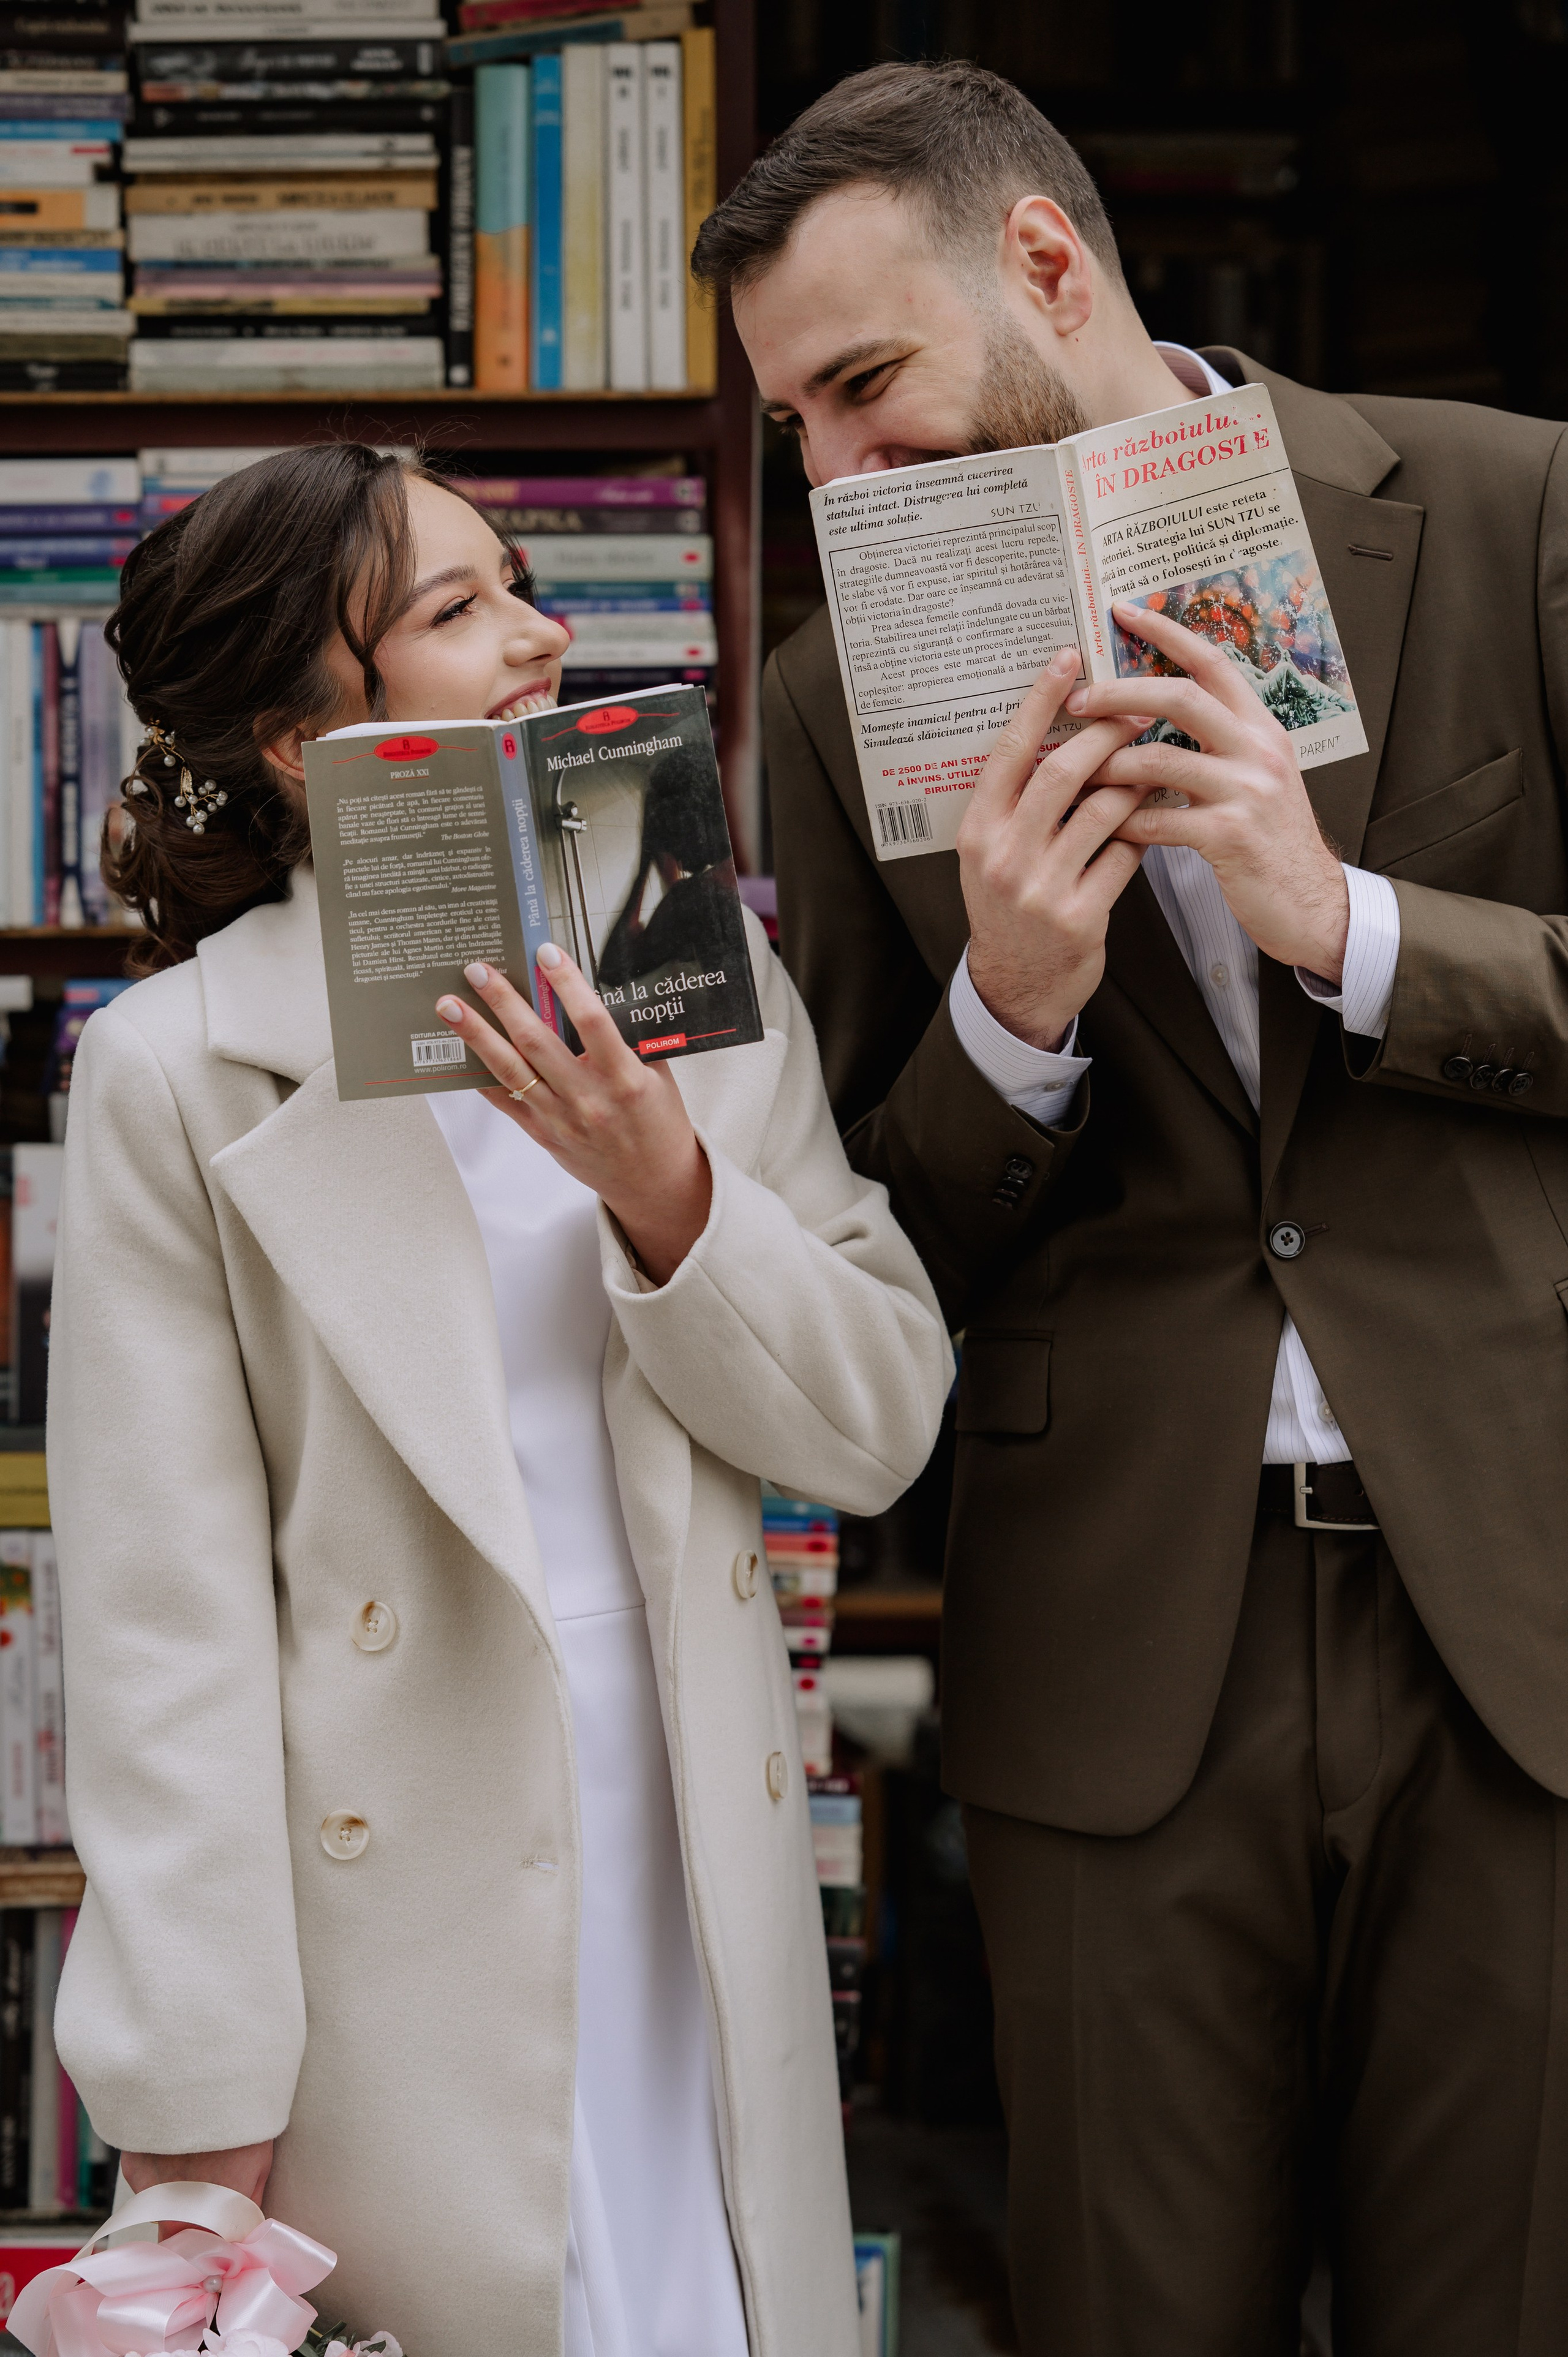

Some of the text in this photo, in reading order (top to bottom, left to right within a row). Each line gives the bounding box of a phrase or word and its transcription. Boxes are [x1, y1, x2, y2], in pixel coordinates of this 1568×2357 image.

[1095, 428, 1269, 499] ÎN DRAGOSTE
[823, 493, 835, 506] În
[837, 488, 870, 503] război
[872, 481, 912, 497] victoria
[914, 472, 964, 489] înseamnă
[826, 478, 1028, 521] statului intact. Distrugerea lui completă
[990, 502, 1040, 517] SUN TZU
[1102, 530, 1123, 547] ARTA
[1126, 506, 1202, 538] RĂZBOIULUI
[1205, 502, 1229, 514] este
[829, 526, 847, 536] este
[850, 519, 884, 532] ultima
[904, 538, 941, 552] victoriei
[943, 530, 987, 546] reprezintă
[988, 523, 1035, 540] principalul
[1037, 522, 1056, 532] scop
[1136, 531, 1187, 552] Strategia
[1188, 524, 1205, 537] lui
[1207, 515, 1235, 532] SUN
[1237, 506, 1264, 522] TZU
[1268, 505, 1280, 514] se
[839, 574, 883, 589] strategiile
[884, 562, 948, 581] dumneavoastă
[966, 557, 972, 566] fi
[974, 550, 1027, 565] descoperite,
[1028, 547, 1060, 559] puncte-
[850, 562, 889, 575] dragoste.
[893, 555, 917, 567] Dacă
[975, 542, 998, 552] acest
[1001, 539, 1024, 548] lucru
[1027, 534, 1058, 546] repede,
[1065, 469, 1104, 657] Arta războiului... ÎN DRAGOSTE
[1116, 567, 1126, 576] în
[1172, 538, 1216, 563] politică
[841, 592, 850, 601] le
[851, 589, 875, 599] slabe
[876, 585, 888, 594] vă
[907, 580, 914, 589] fi
[916, 576, 950, 588] expuse,
[952, 573, 964, 581] iar
[967, 565, 998, 580] spiritul
[1009, 560, 1050, 571] hotărârea
[1137, 575, 1150, 586] să
[1213, 554, 1226, 564] în
[861, 601, 867, 610] fi
[870, 597, 905, 608] erodate.
[907, 593, 924, 602] Dar
[926, 589, 946, 598] oare
[959, 578, 1002, 592] înseamnă
[1017, 571, 1054, 583] adevărat
[1055, 569, 1064, 578] să
[867, 608, 901, 620] victoria
[901, 606, 911, 615] în
[912, 598, 954, 613] dragoste?
[907, 711, 951, 727] inamicul
[953, 707, 987, 723] pentru
[990, 702, 1003, 713] a-l
[1062, 722, 1081, 731] TZU
[546, 736, 683, 772] Michael Cunningham
[863, 732, 914, 749] Simulează
[390, 769, 415, 779] PROZĂ
[881, 768, 895, 777] DE
[897, 764, 921, 774] 2500
[924, 762, 938, 771] DE
[940, 759, 957, 768] ANI
[906, 774, 944, 785] ÎNVINS.
[1153, 790, 1170, 803] DR.
[520, 836, 534, 881] căderea
[524, 884, 537, 896] la
[527, 898, 540, 927] Până
[630, 981, 649, 1001] la
[654, 970, 727, 996] căderea
[646, 1038, 680, 1050] POLIROM
[414, 1064, 467, 1073] www.polirom.ro
